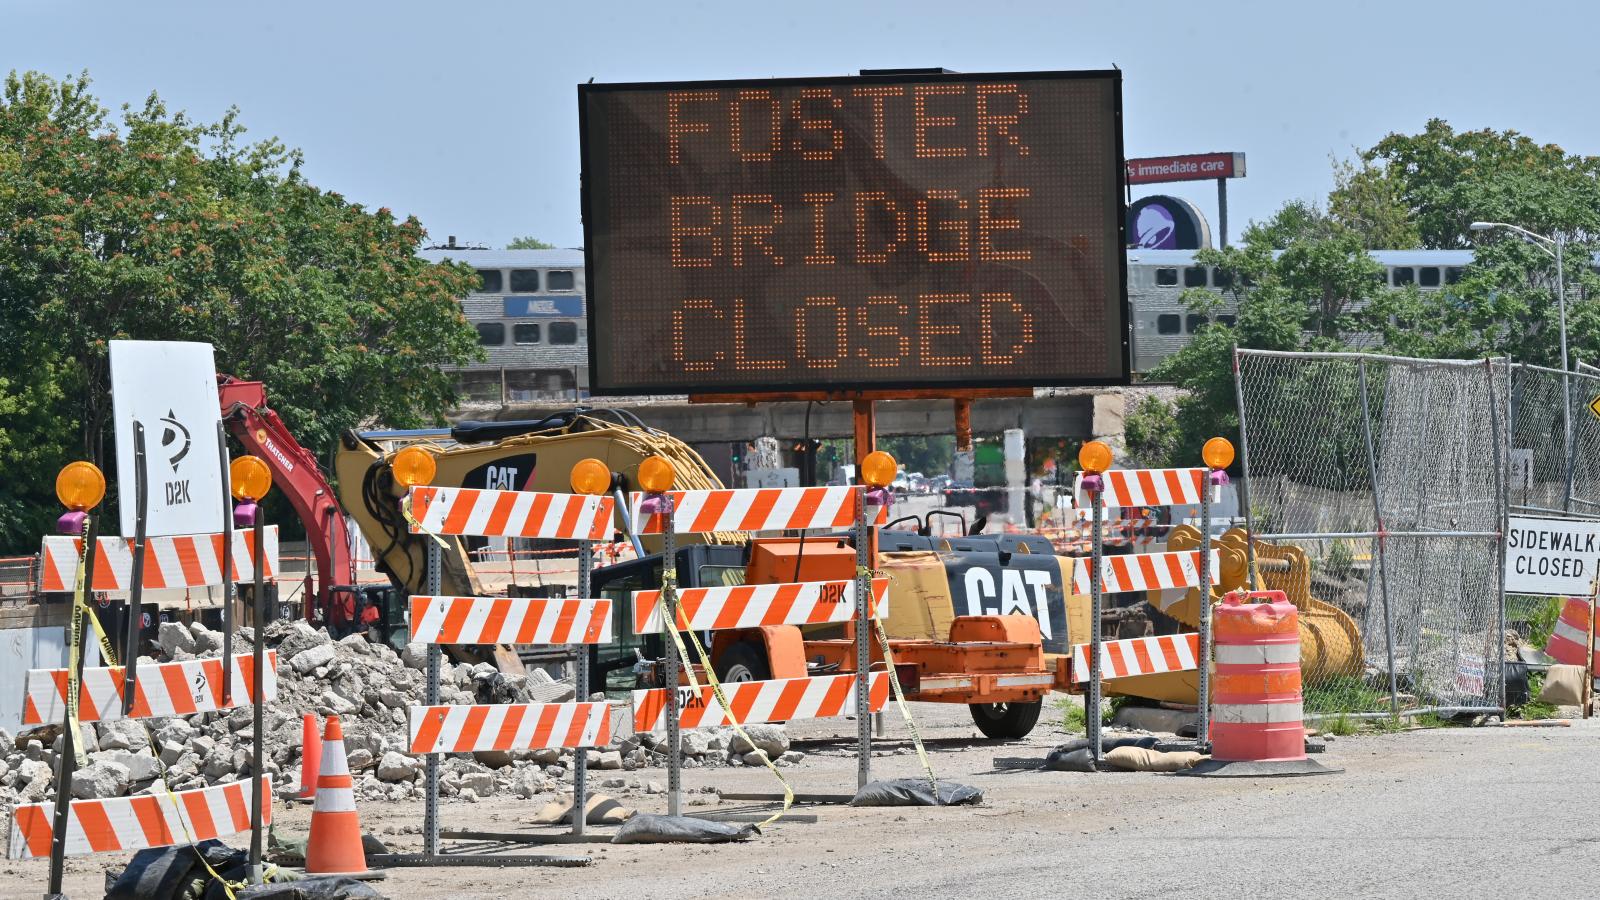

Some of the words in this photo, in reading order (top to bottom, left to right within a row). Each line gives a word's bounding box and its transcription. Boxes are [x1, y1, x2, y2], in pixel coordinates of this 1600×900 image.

[669, 84, 1028, 164] FOSTER
[1138, 161, 1198, 176] immediate
[1201, 160, 1225, 172] care
[671, 188, 1031, 267] BRIDGE
[673, 293, 1034, 371] CLOSED
[264, 437, 294, 473] THATCHER
[486, 465, 518, 491] CAT
[165, 479, 192, 506] D2K
[1508, 528, 1596, 553] SIDEWALK
[1515, 555, 1584, 578] CLOSED
[819, 584, 847, 604] D2K
[964, 566, 1053, 640] CAT
